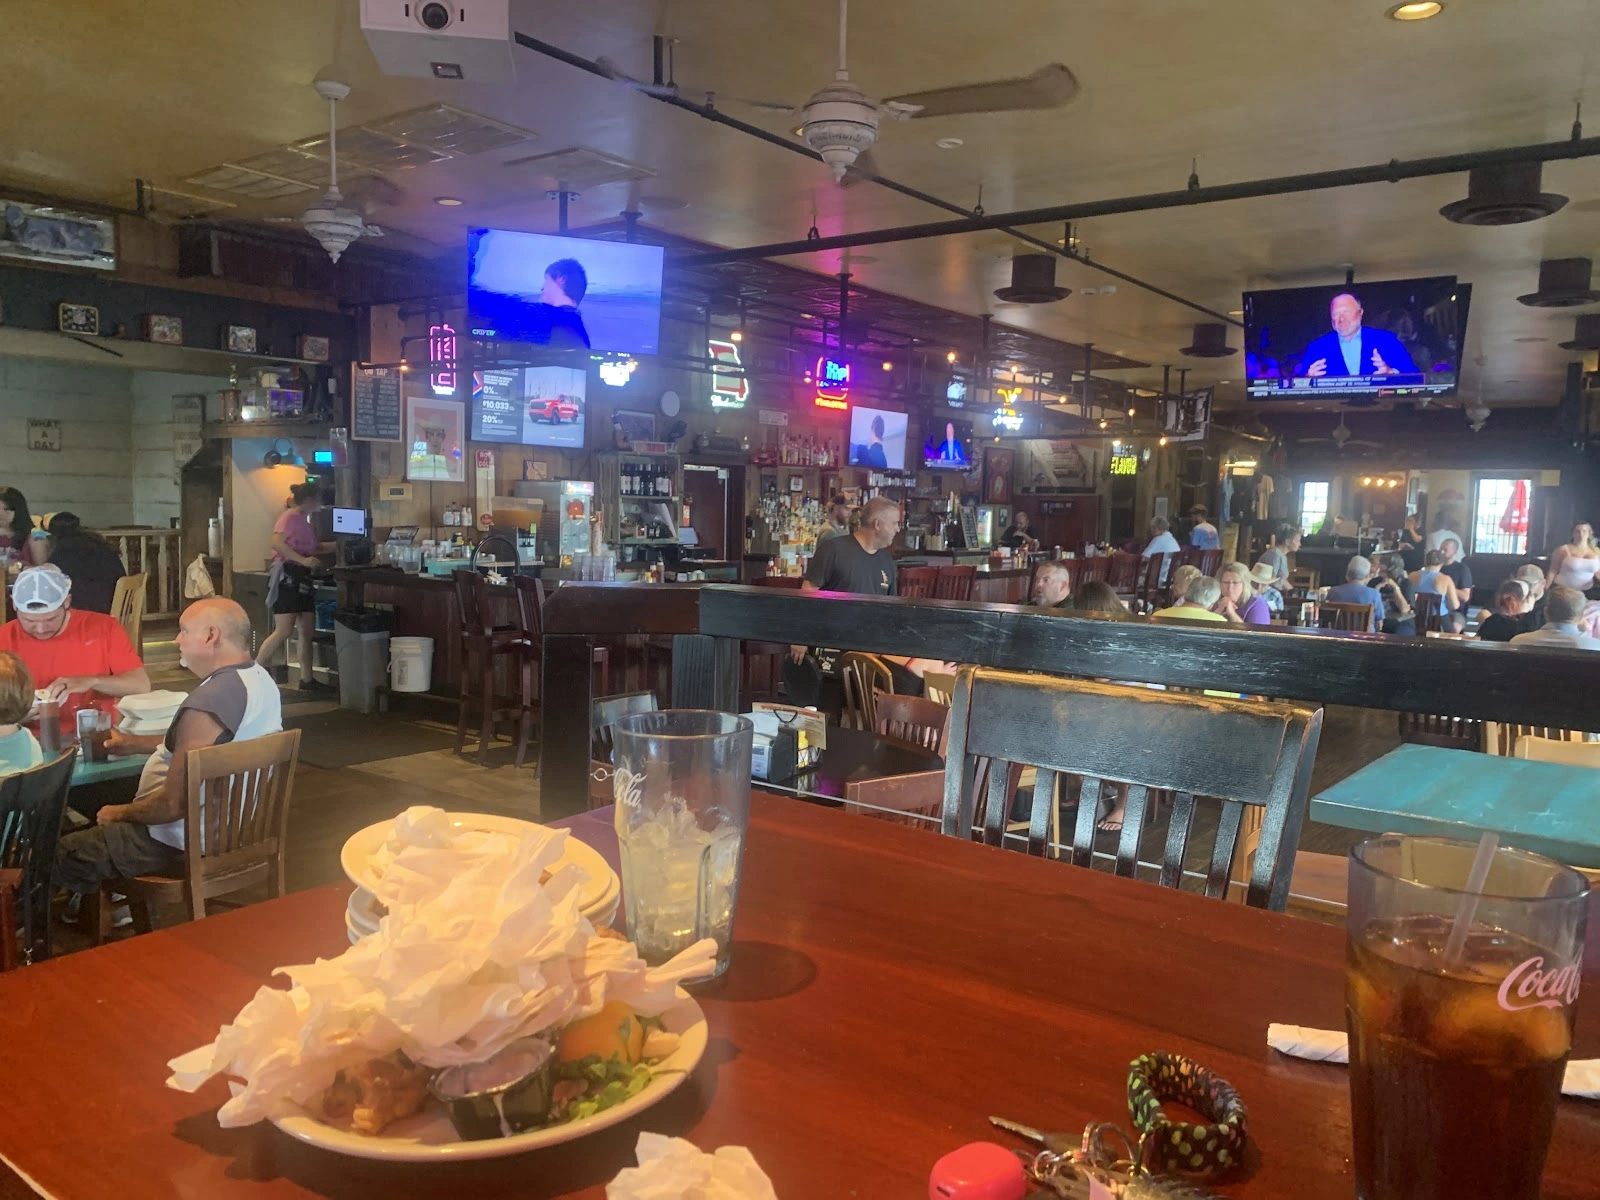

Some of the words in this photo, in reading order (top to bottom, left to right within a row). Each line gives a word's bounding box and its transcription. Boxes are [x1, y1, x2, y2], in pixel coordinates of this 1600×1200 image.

[375, 368, 388, 376] TAP
[483, 385, 495, 394] 0%
[482, 400, 509, 410] $10,033
[30, 419, 60, 428] WHAT
[482, 415, 498, 424] 20%
[41, 430, 49, 438] A
[34, 440, 55, 449] DAY
